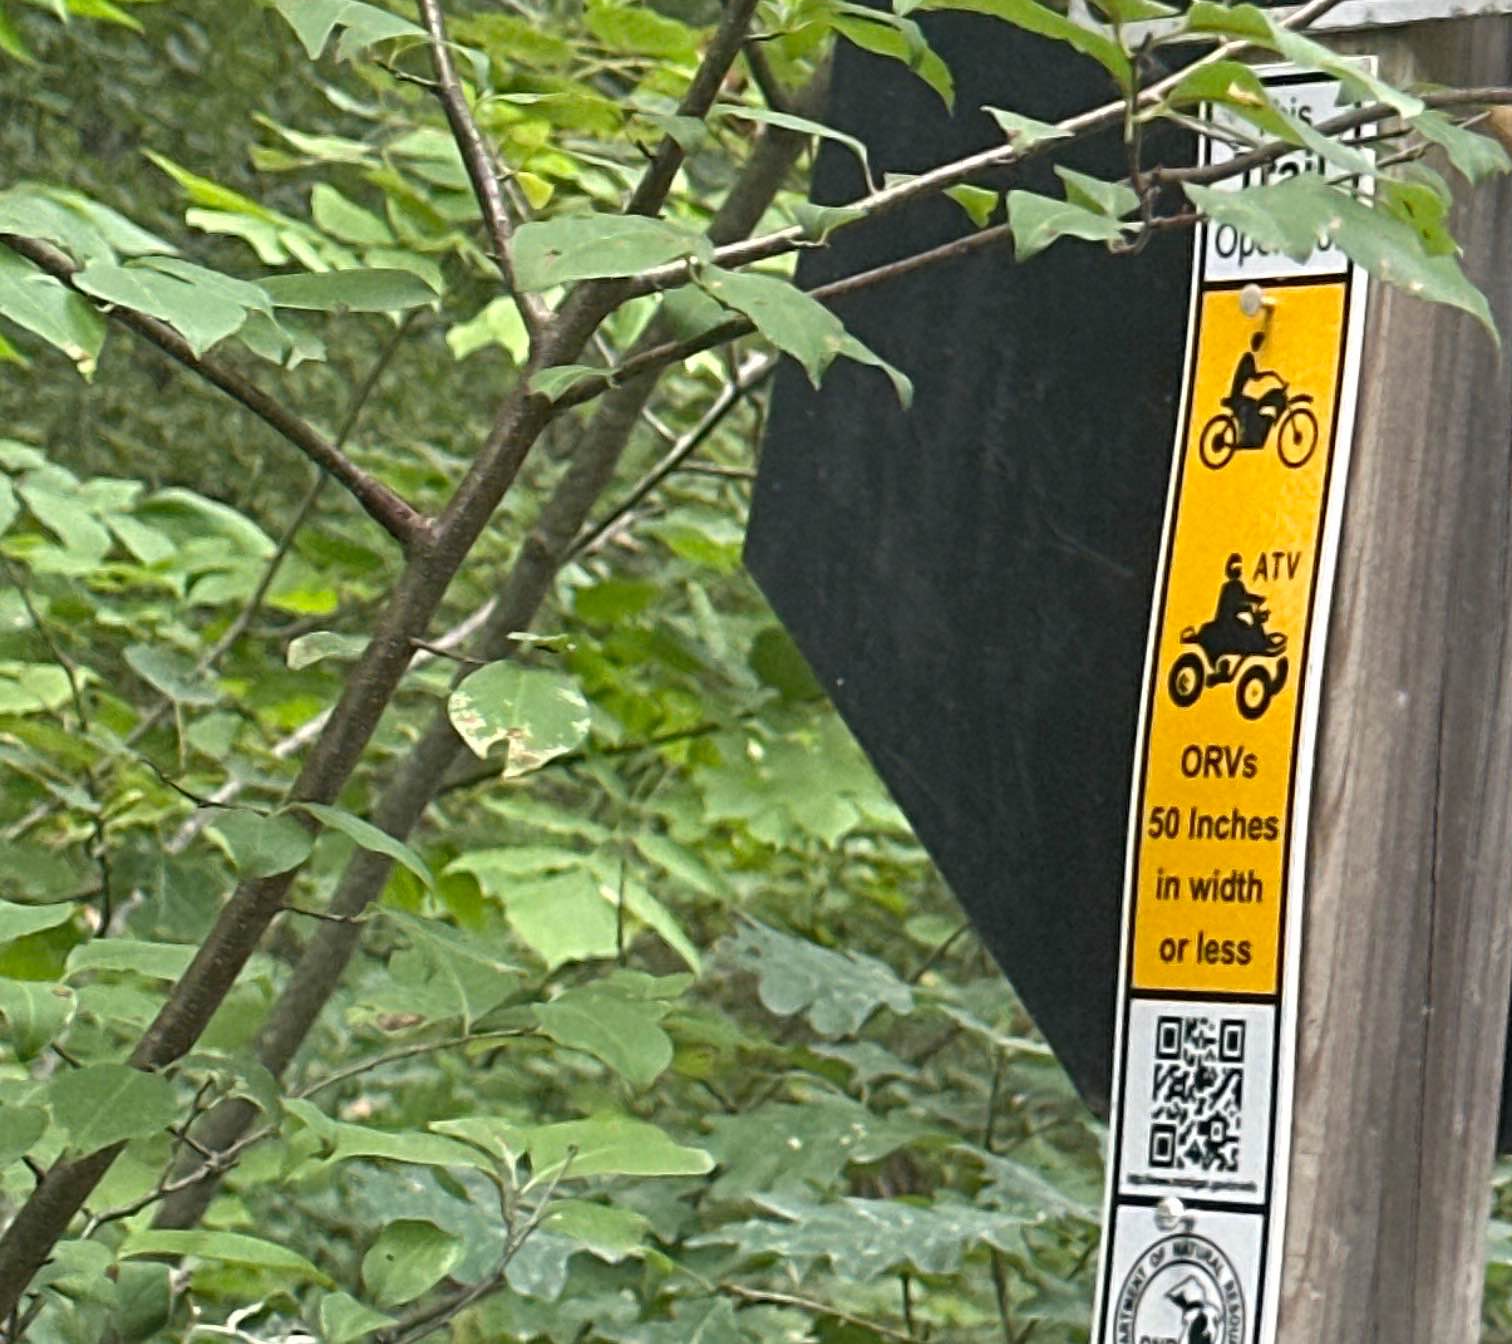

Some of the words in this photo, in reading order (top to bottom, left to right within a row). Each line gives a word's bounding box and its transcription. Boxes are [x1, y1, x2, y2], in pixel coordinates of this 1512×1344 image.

[1253, 551, 1302, 581] ATV
[1181, 744, 1258, 779] ORVs
[1148, 806, 1180, 839] 50
[1188, 806, 1279, 841] Inches
[1156, 867, 1180, 900] in
[1190, 868, 1263, 903] width
[1159, 937, 1190, 964] or
[1197, 930, 1252, 965] less
